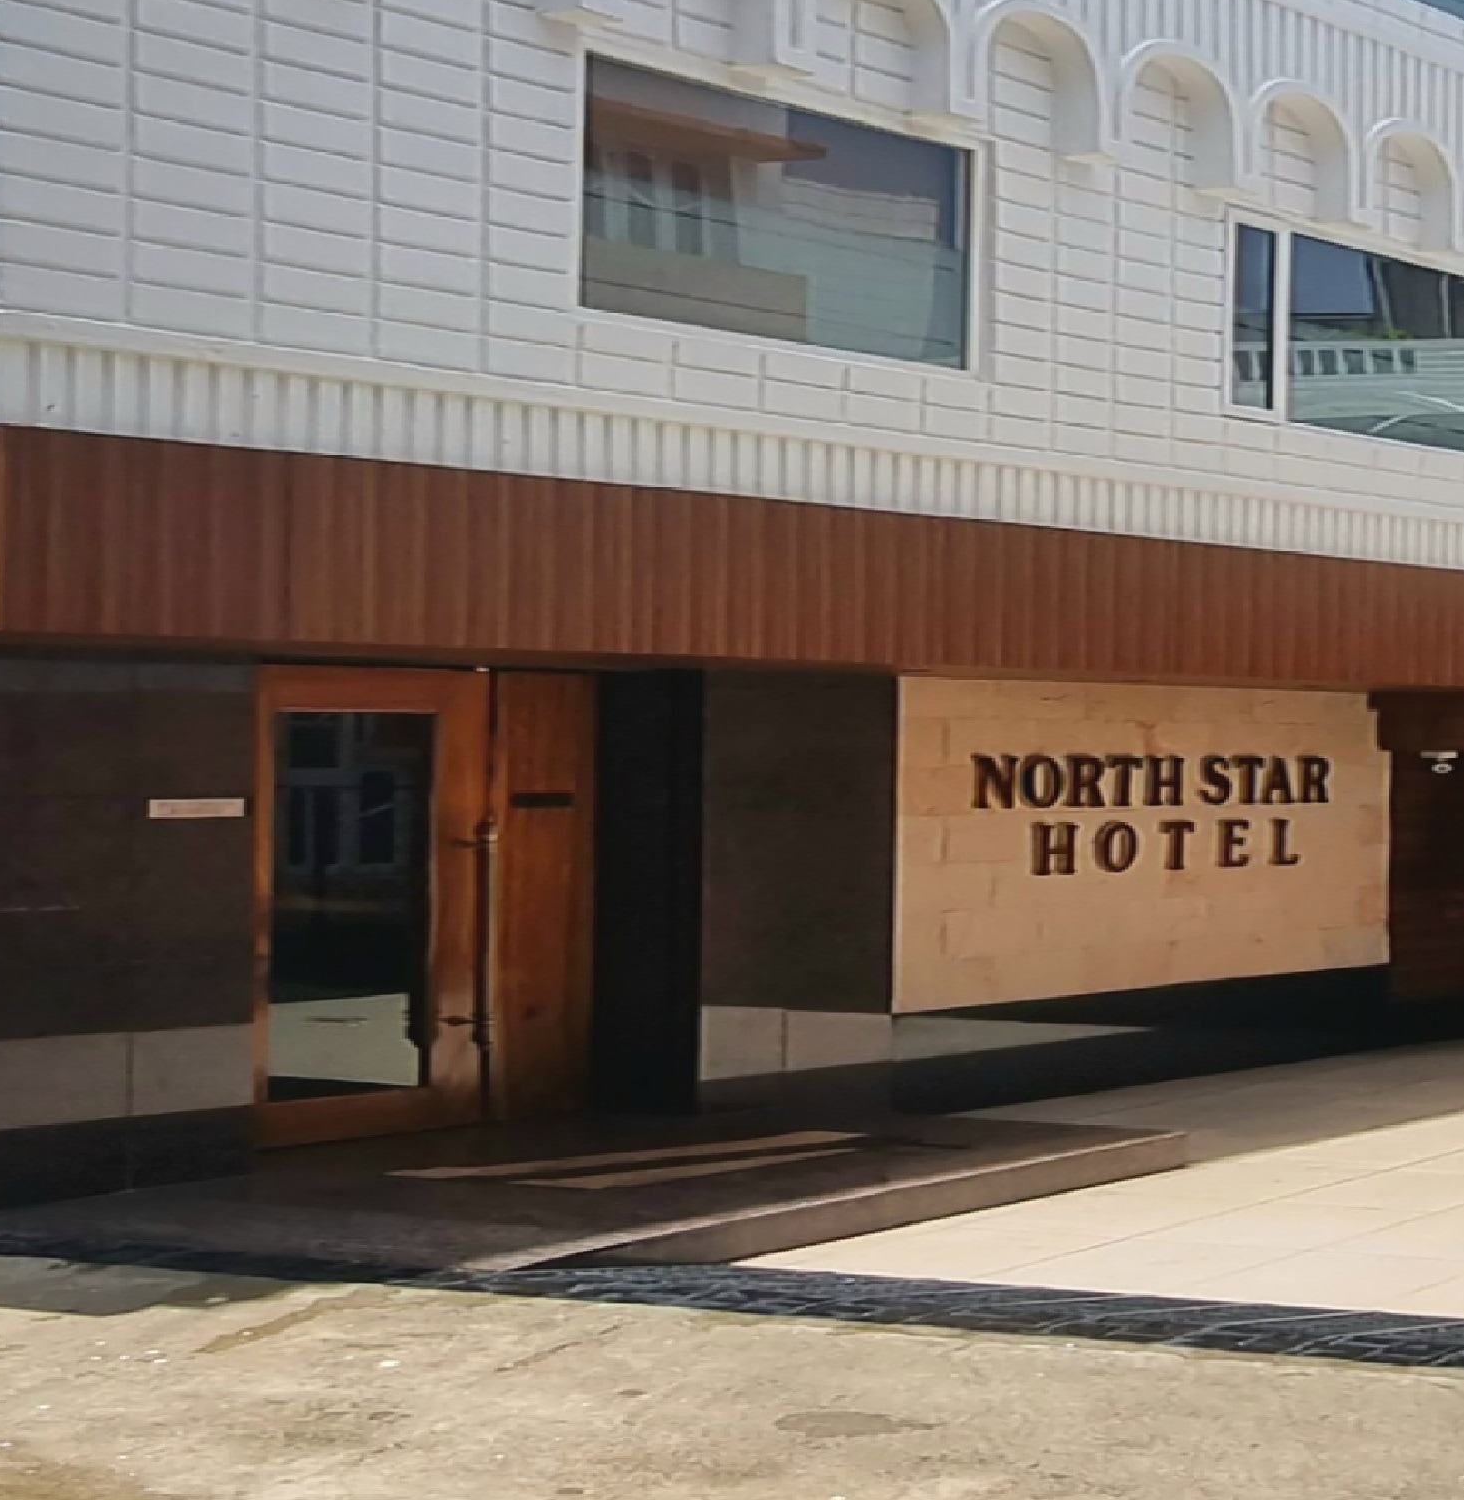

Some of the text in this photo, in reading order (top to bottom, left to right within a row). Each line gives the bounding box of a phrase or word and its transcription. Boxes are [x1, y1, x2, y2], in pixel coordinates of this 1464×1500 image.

[969, 752, 1331, 809] NORTH STAR
[1030, 816, 1302, 877] HOTEL
